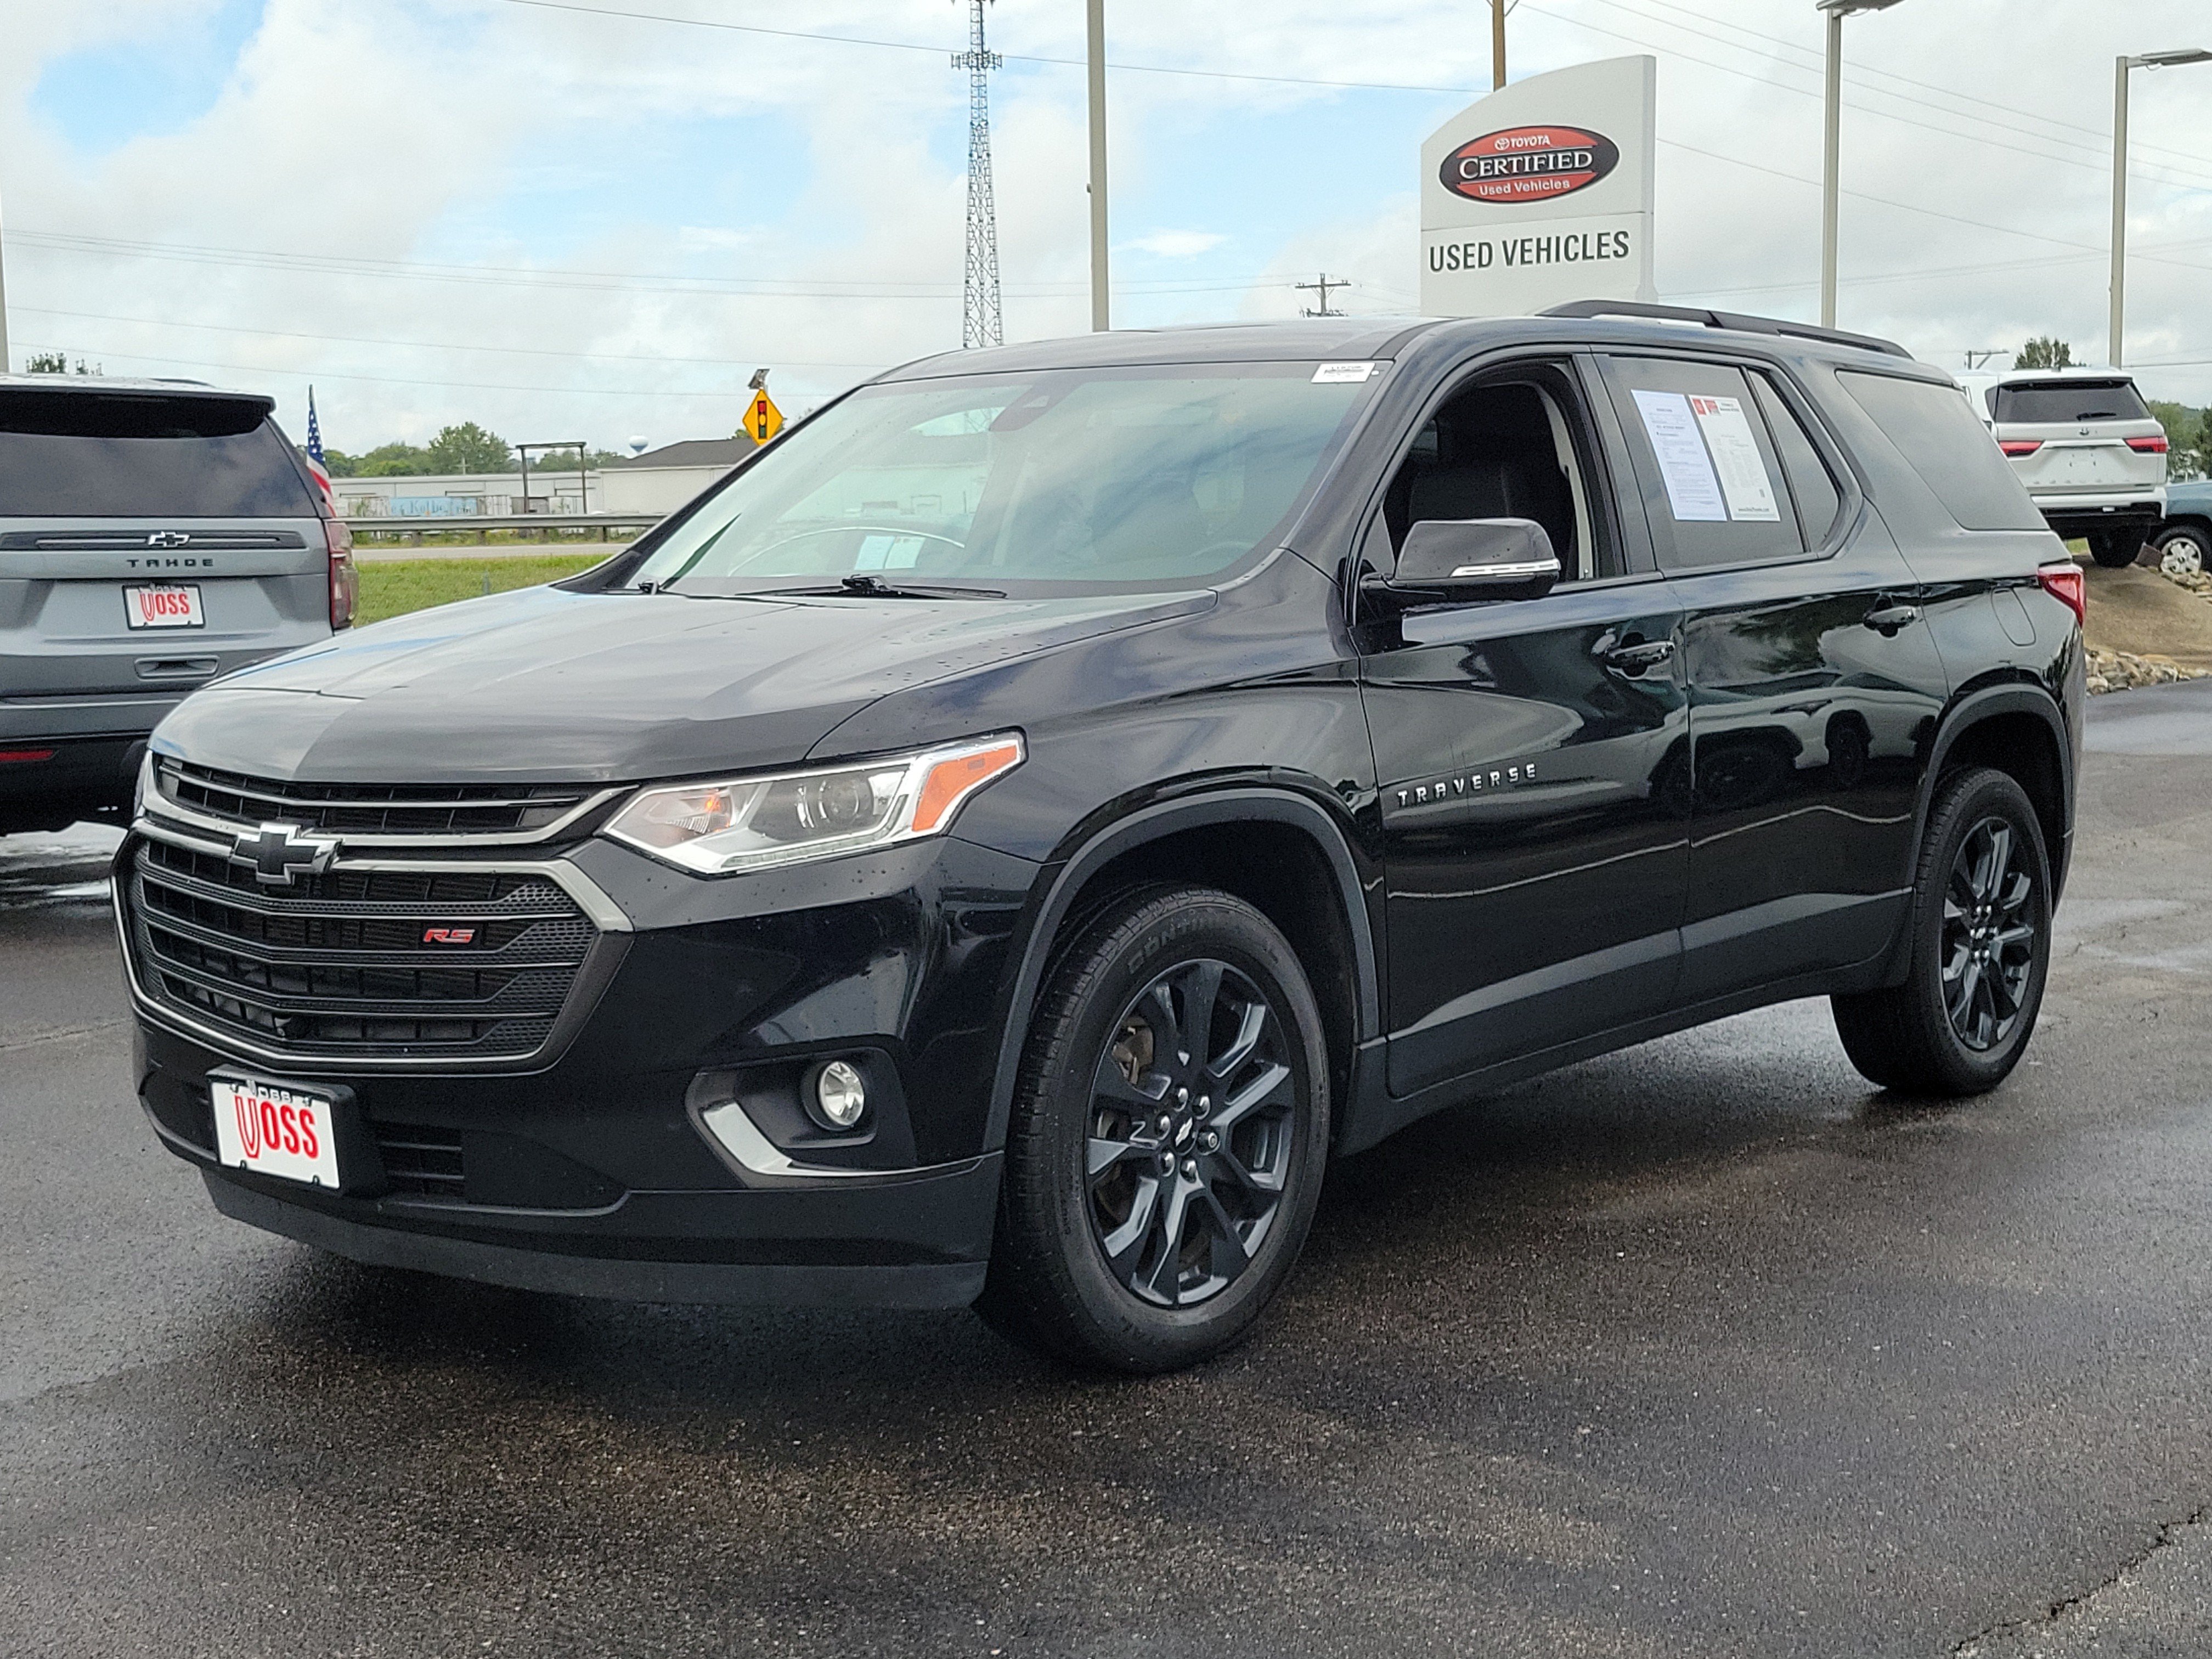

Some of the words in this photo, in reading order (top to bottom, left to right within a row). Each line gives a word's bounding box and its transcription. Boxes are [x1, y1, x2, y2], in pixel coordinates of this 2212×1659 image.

[1511, 136, 1551, 148] TOYOTA
[1479, 184, 1511, 196] Used
[1514, 179, 1570, 193] Vehicles
[1429, 242, 1493, 272] USED
[1502, 230, 1629, 267] VEHICLES
[126, 558, 214, 568] TAHOE
[139, 592, 190, 622] VOSS
[1398, 763, 1536, 806] TRAVERSE
[423, 928, 475, 944] RS
[234, 1095, 319, 1159] VOSS
